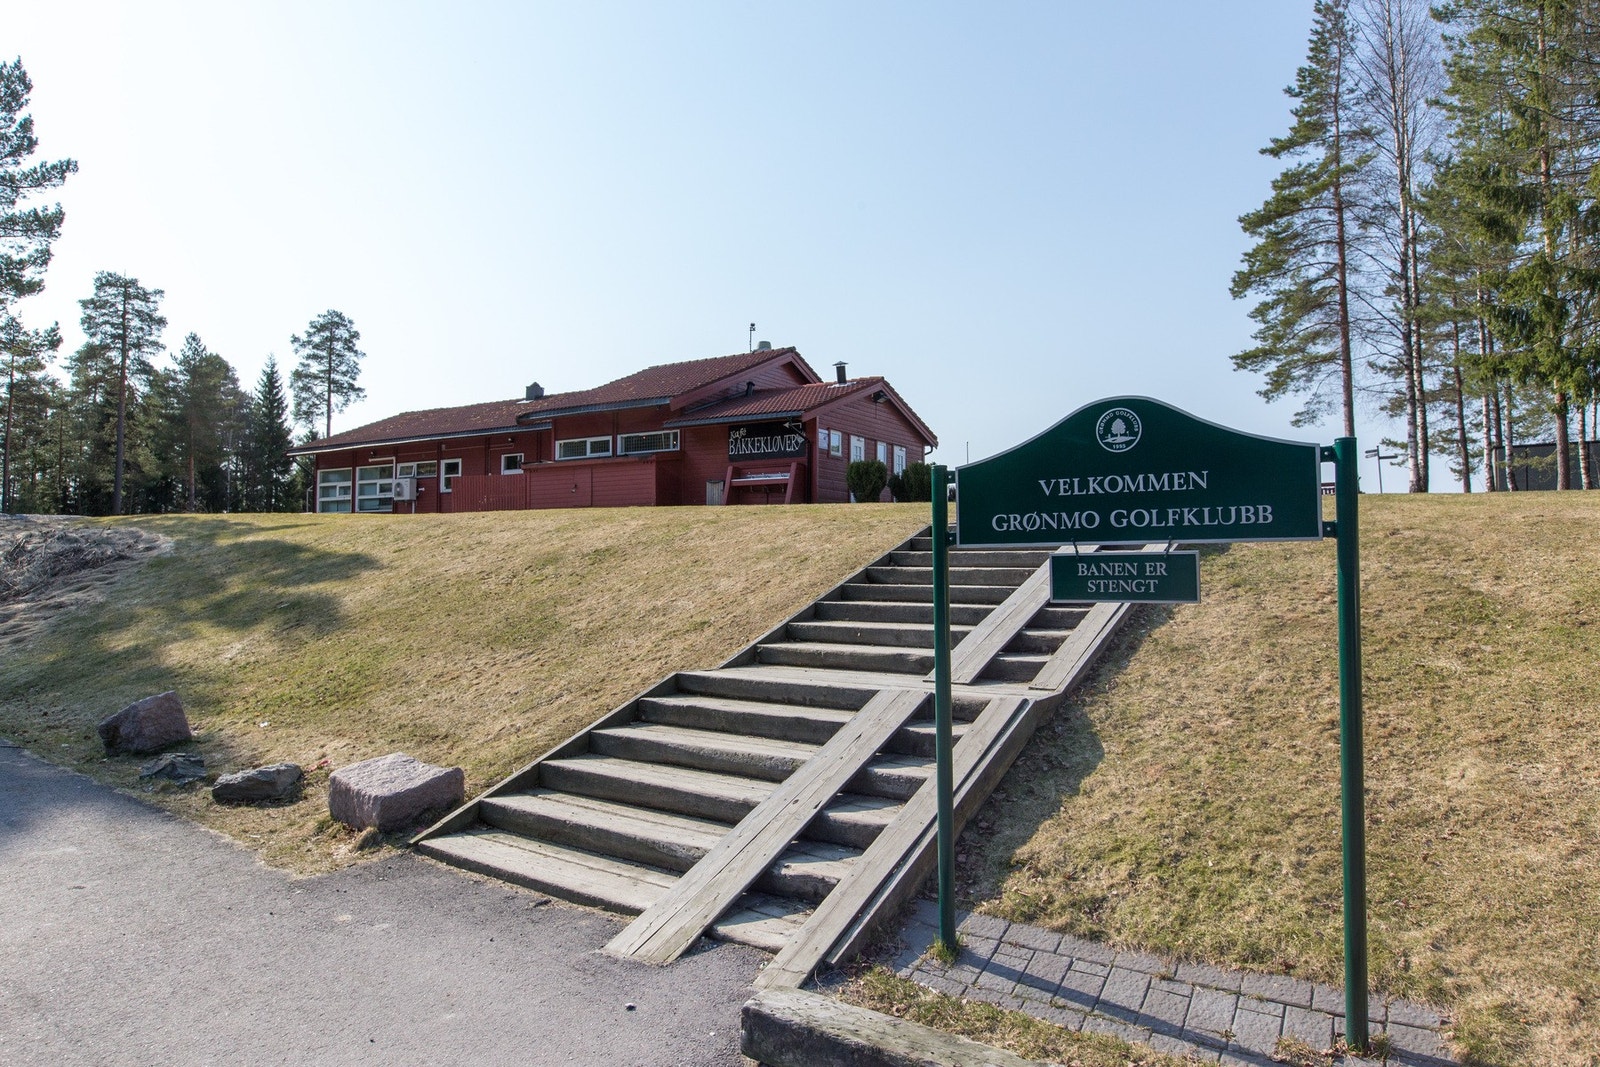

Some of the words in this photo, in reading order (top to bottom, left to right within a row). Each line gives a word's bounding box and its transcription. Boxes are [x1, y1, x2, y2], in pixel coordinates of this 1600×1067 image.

[1038, 470, 1209, 496] VELKOMMEN
[991, 510, 1100, 532] GRØNMO
[1109, 504, 1274, 528] GOLFKLUBB
[1077, 562, 1138, 577] BANEN
[1145, 562, 1168, 576] ER
[1087, 579, 1159, 593] STENGT
